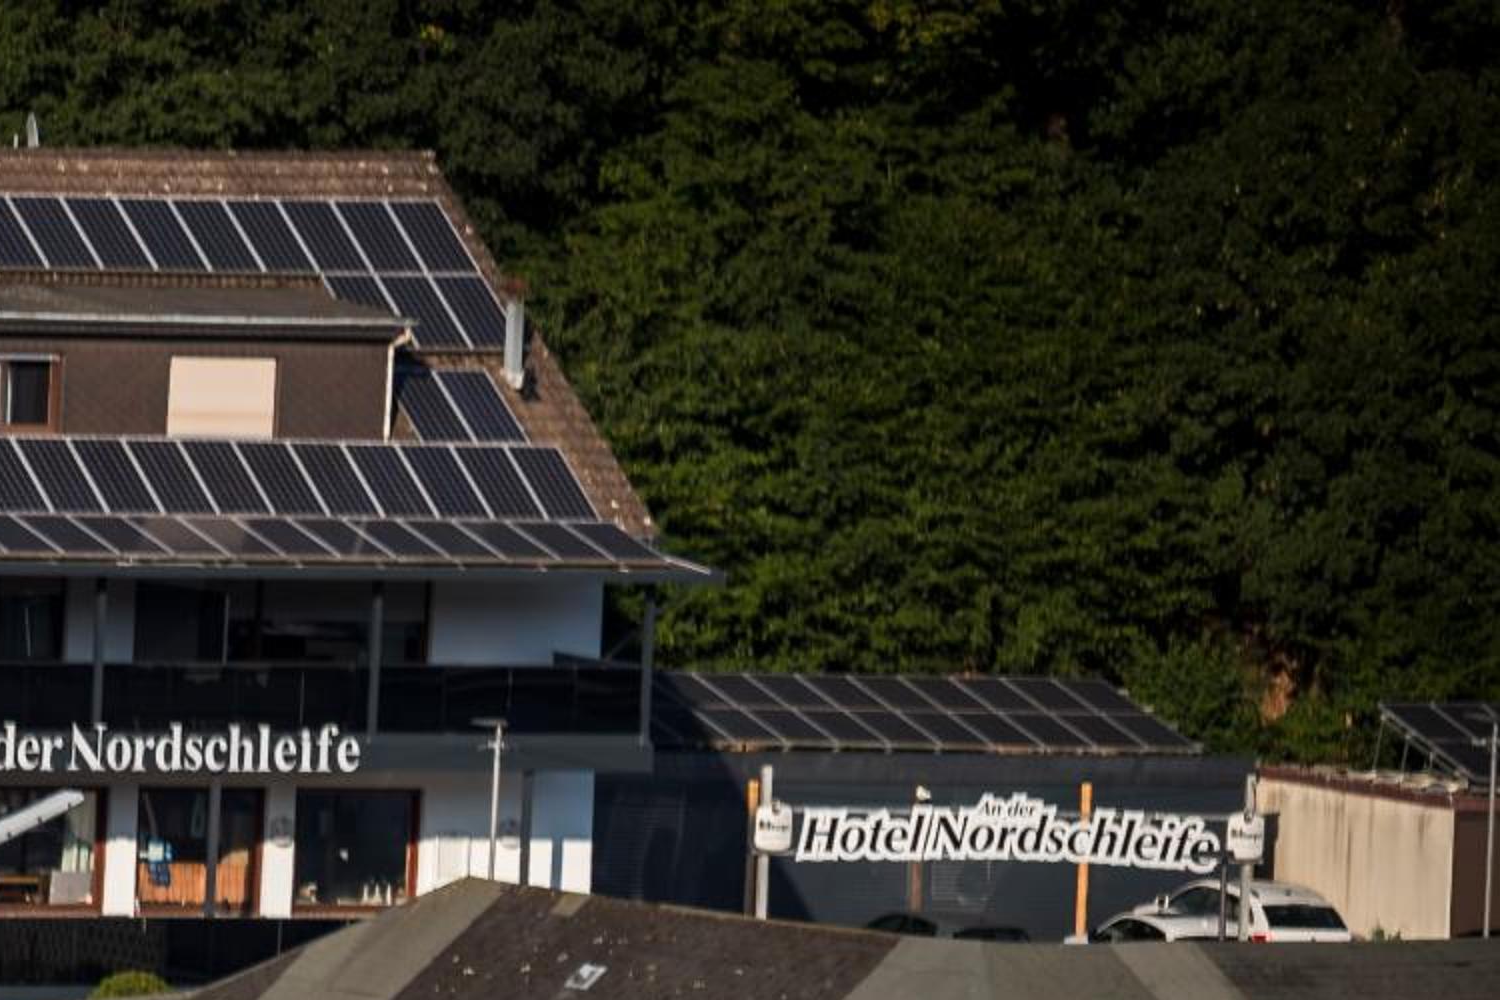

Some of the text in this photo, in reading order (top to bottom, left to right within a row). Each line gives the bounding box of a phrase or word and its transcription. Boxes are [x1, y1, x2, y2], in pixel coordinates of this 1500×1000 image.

[67, 721, 361, 773] Nordschleife
[1007, 798, 1036, 817] der
[803, 812, 1216, 868] Hotel Nordschleife
